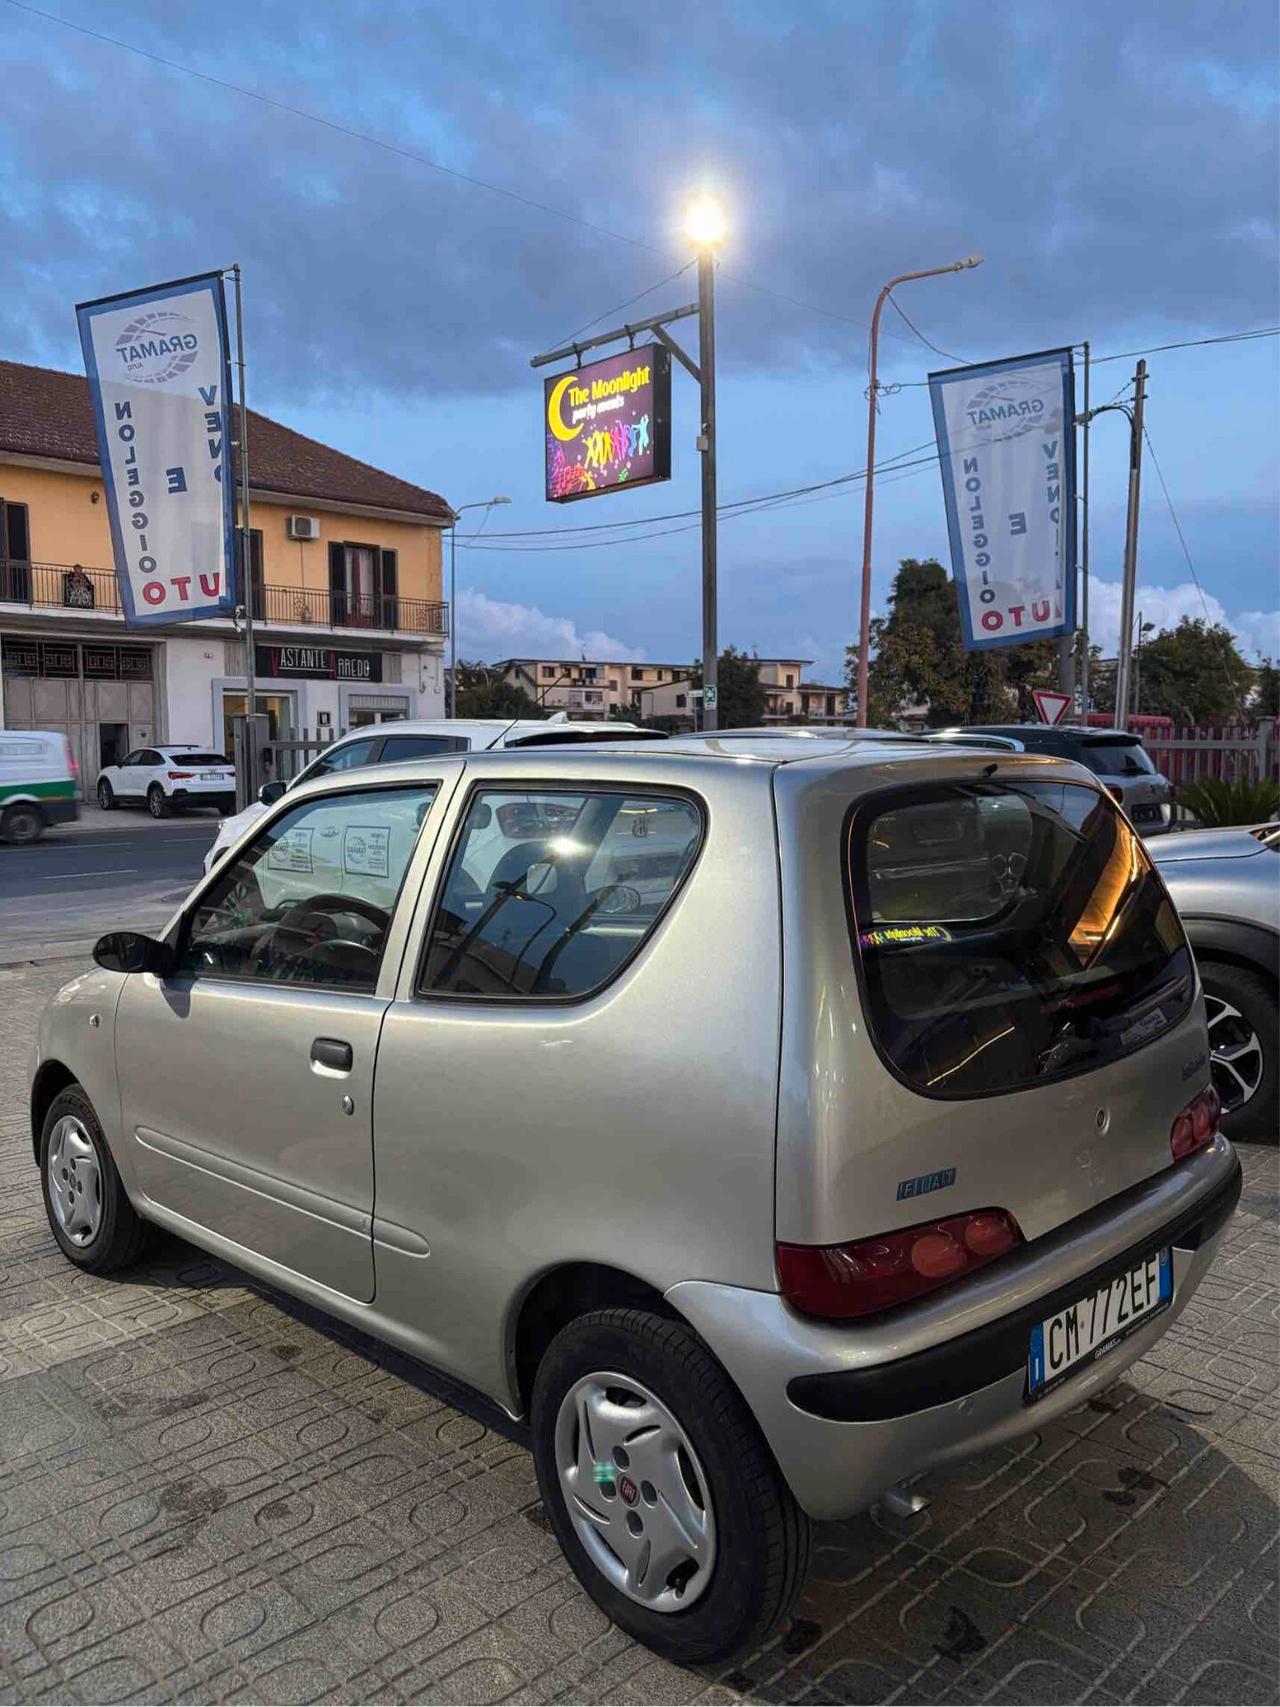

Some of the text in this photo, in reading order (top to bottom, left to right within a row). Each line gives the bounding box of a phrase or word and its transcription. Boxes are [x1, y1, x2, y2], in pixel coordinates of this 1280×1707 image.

[568, 366, 651, 407] The Moonlight
[572, 403, 596, 425] party
[329, 651, 370, 679] ARREDO
[902, 1169, 956, 1199] FIAT
